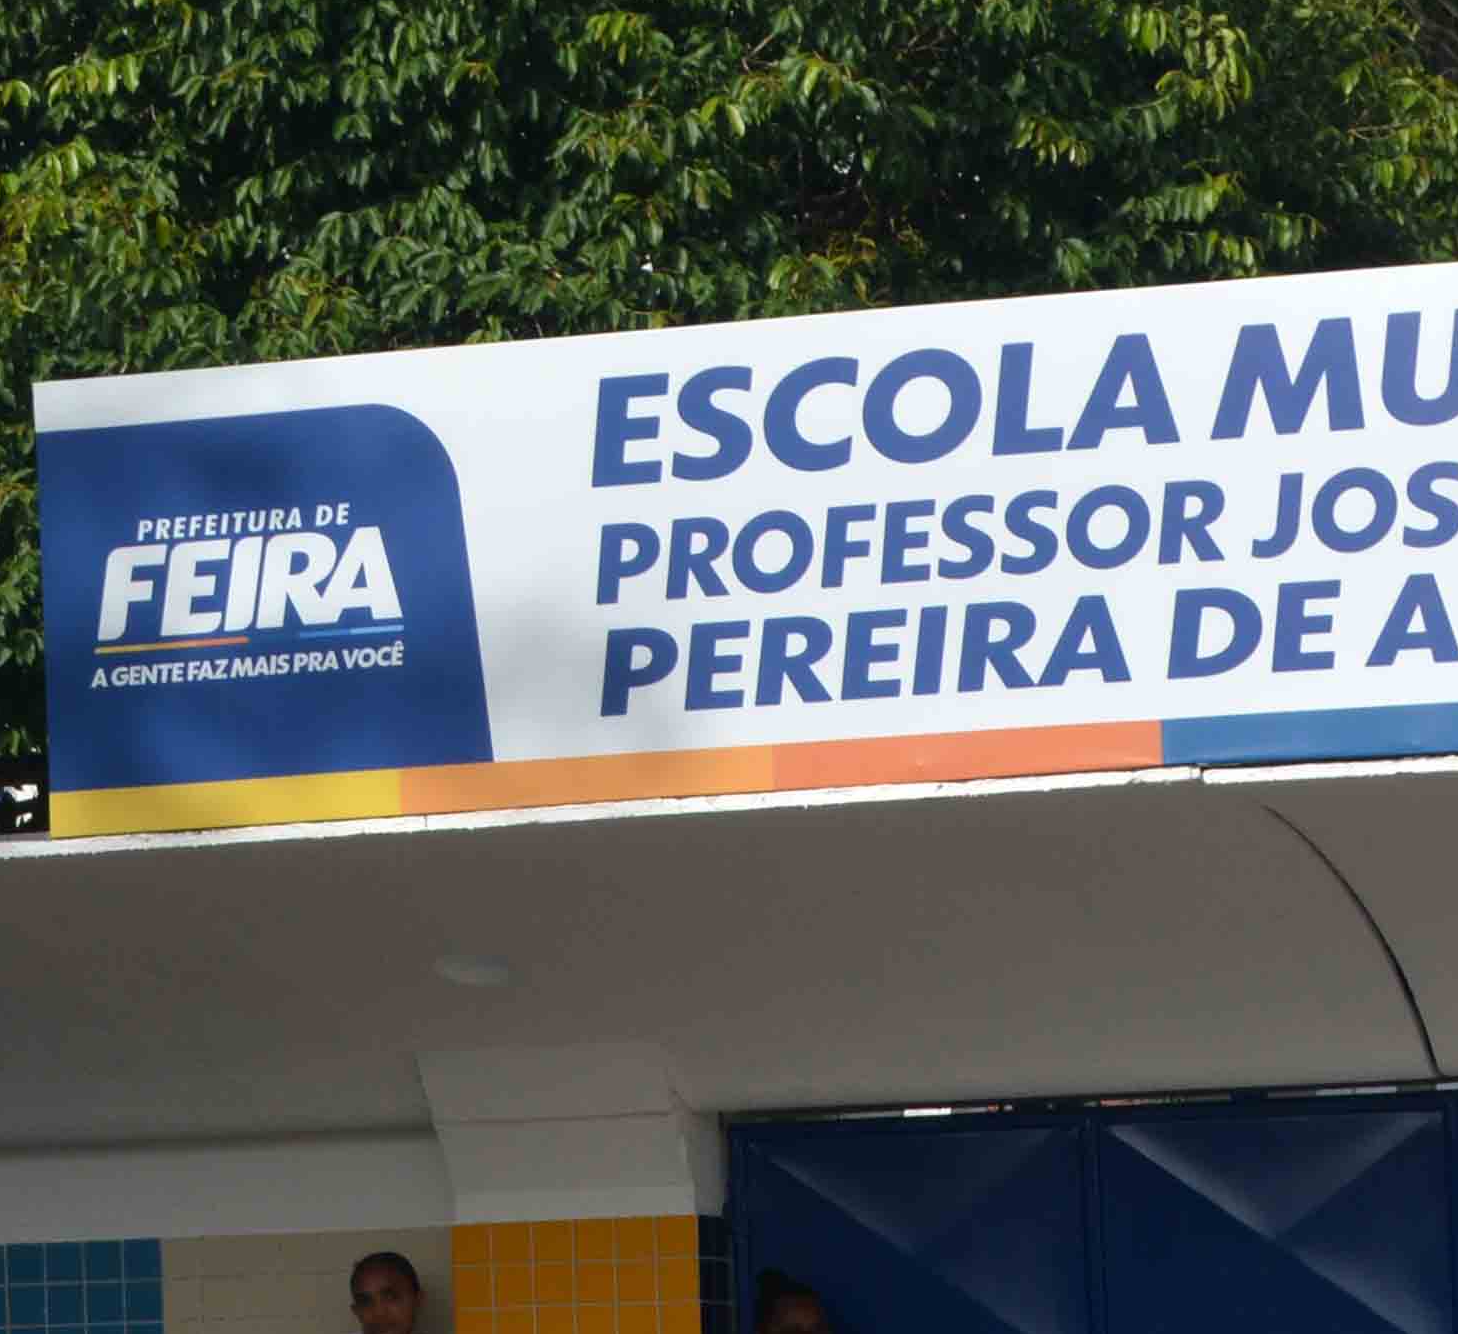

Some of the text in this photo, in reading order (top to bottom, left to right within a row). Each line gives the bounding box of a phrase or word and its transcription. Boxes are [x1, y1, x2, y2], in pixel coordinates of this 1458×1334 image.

[592, 332, 1180, 488] ESCOLA
[136, 501, 351, 542] PREFEITURA DE
[596, 479, 1226, 605] PROFESSOR
[96, 525, 404, 642] FEIRA
[90, 640, 406, 690] A GENTE FAZ MAIS PRA VOCÊ
[600, 594, 1132, 718] PEREIRA
[1166, 579, 1342, 680] DE
